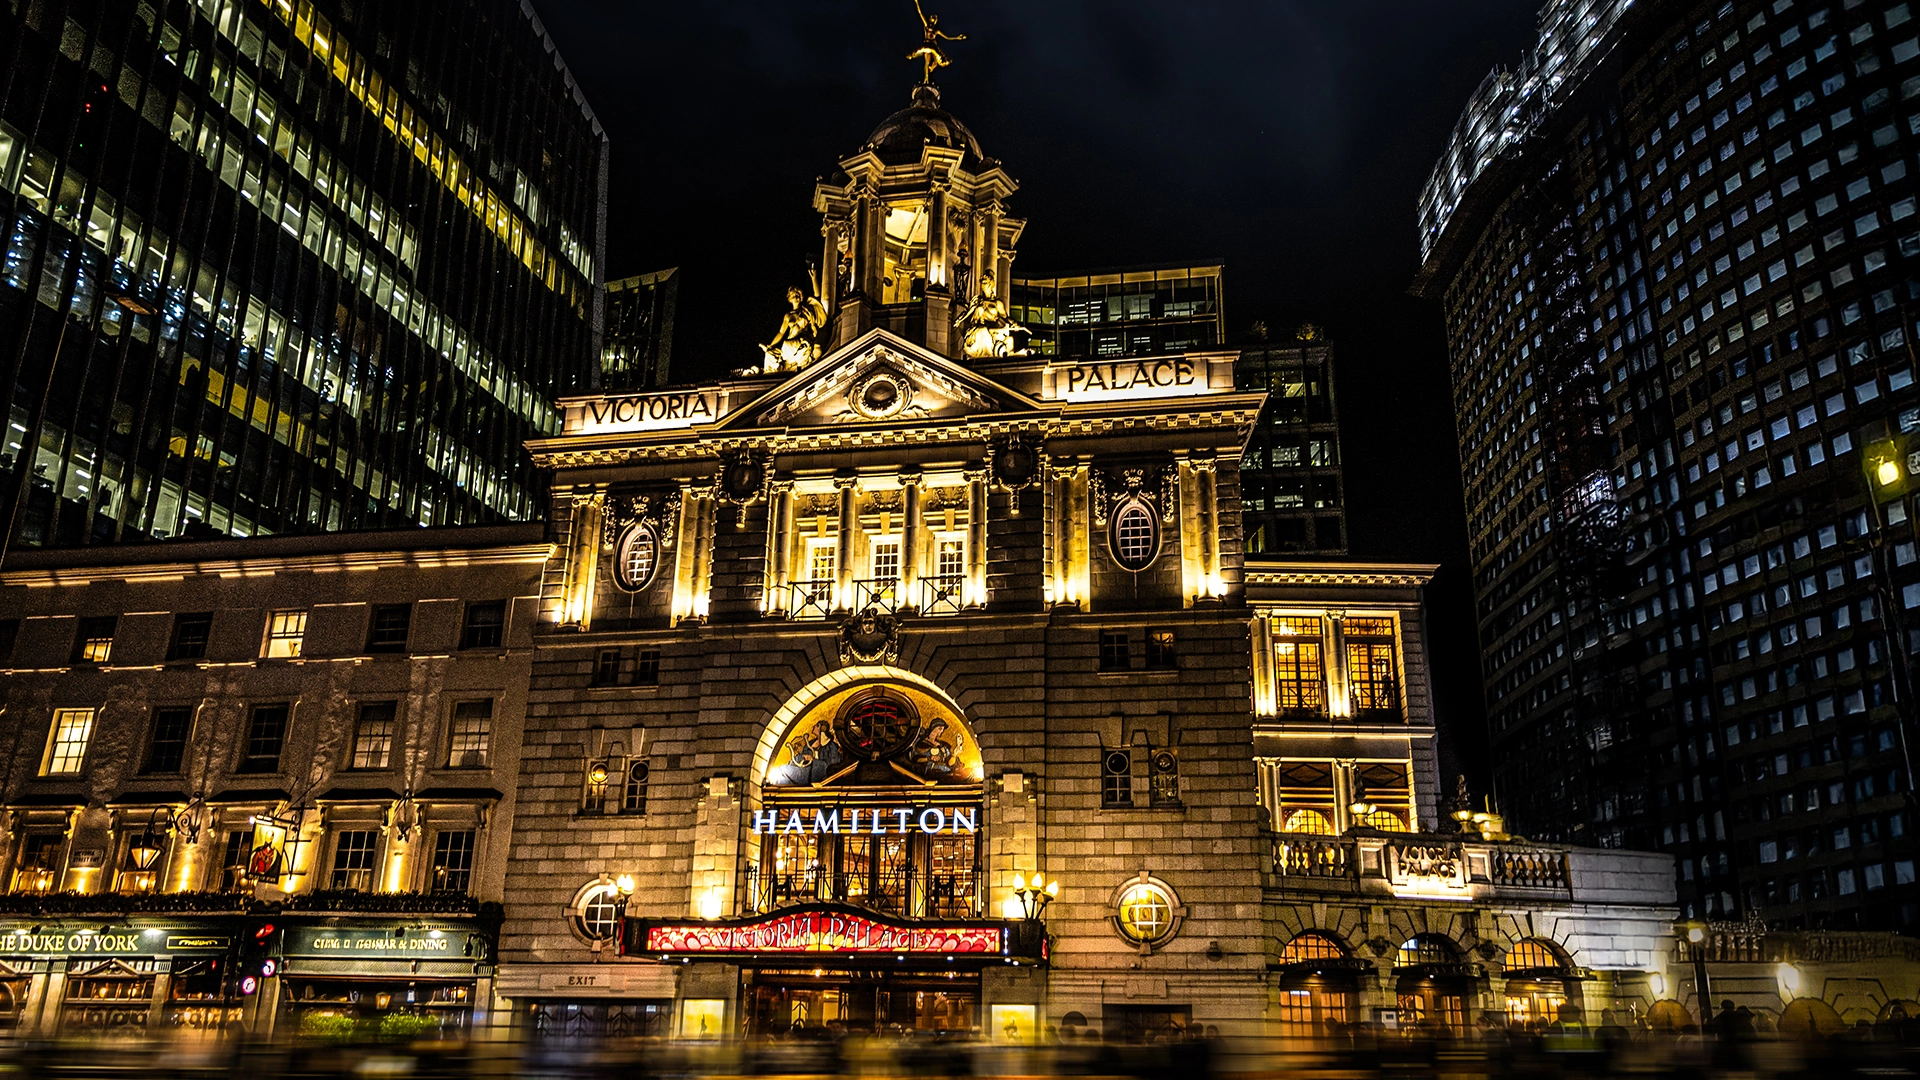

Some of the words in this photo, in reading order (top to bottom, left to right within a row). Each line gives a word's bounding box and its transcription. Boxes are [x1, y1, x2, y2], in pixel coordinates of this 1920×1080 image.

[1068, 360, 1195, 392] PALACE
[588, 394, 712, 424] VICTORIA
[753, 808, 977, 835] HAMILTON
[1393, 845, 1460, 862] VICTORIA
[0, 934, 16, 951] HE
[19, 934, 65, 951] DUKE
[67, 934, 91, 951] OF
[93, 934, 139, 951] YORK
[716, 917, 811, 948] VICTORIA
[830, 917, 926, 949] PALACE
[409, 939, 448, 950] DINING
[568, 976, 596, 986] EXIT
